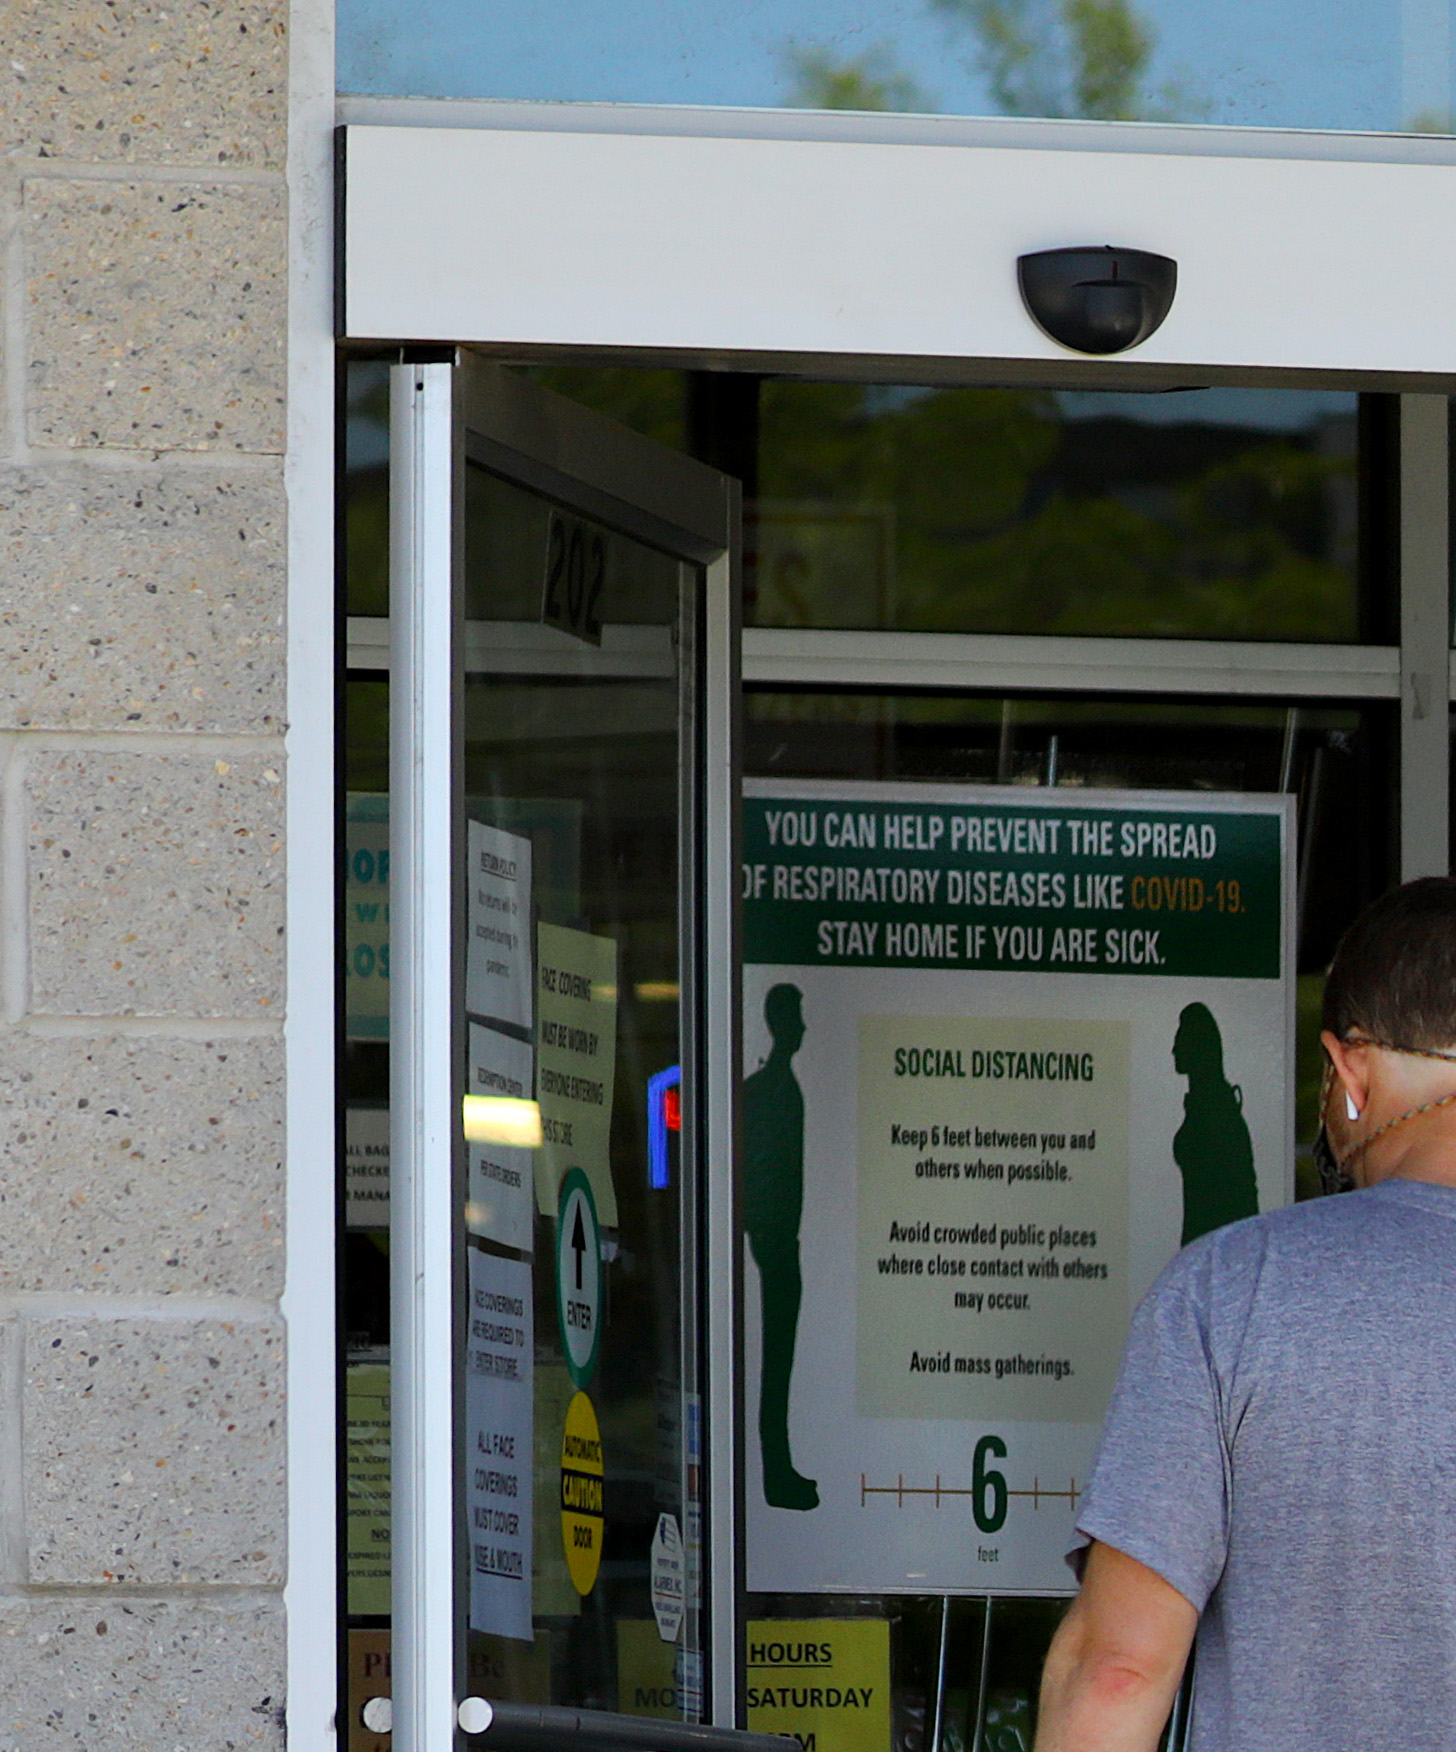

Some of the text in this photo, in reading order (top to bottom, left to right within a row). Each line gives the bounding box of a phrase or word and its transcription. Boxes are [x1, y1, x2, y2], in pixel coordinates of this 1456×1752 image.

[545, 517, 606, 637] 202
[766, 811, 1217, 860] YOU CAN HELP PREVENT THE SPREAD
[773, 866, 940, 905] RESPIRATORY
[947, 871, 1067, 909] DISEASES
[1074, 875, 1124, 911] LIKE
[1131, 877, 1247, 914] COVID-19.
[818, 921, 1167, 966] STAY HOME IF YOU ARE SICK.
[894, 1047, 1094, 1083] SOCIAL DISTANCING
[891, 1124, 1096, 1153] Keep 6 feet between you and
[915, 1158, 1072, 1185] others when possible.
[889, 1221, 1097, 1251] Avoid crowded public places
[877, 1254, 1108, 1281] where close contact with others
[567, 1300, 592, 1331] ENTER
[954, 1292, 1030, 1314] may occur.
[910, 1351, 1075, 1381] Avoid mass gatherings.
[971, 1435, 1008, 1534] 6
[978, 1546, 999, 1563] feet
[750, 1643, 832, 1664] HOURS
[747, 1687, 873, 1709] SATURDAY
